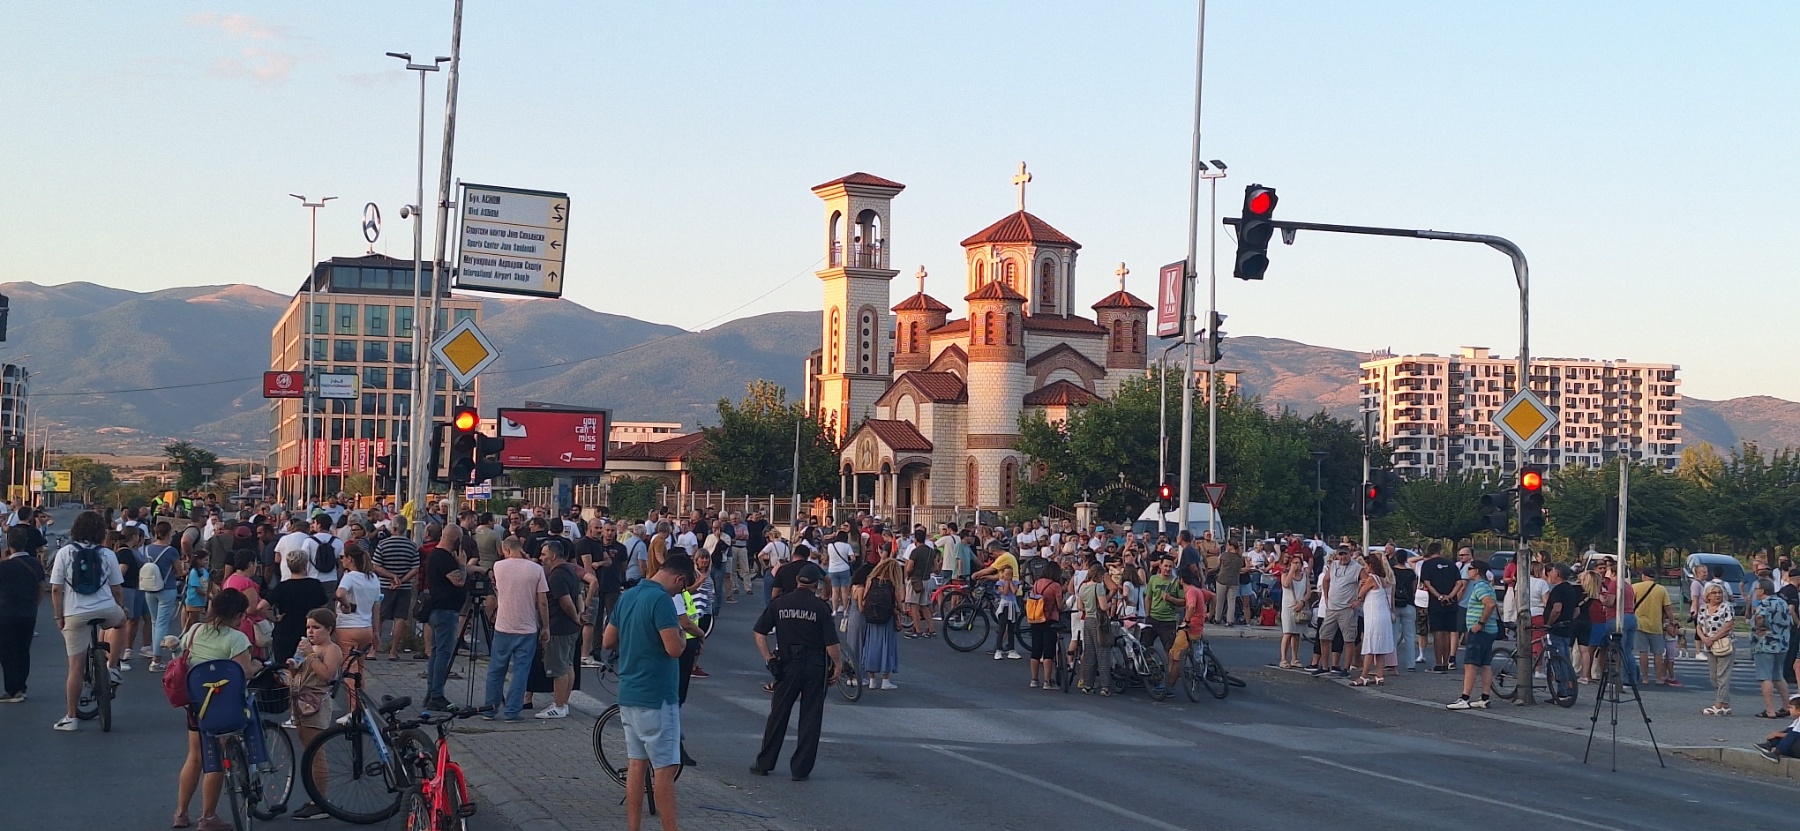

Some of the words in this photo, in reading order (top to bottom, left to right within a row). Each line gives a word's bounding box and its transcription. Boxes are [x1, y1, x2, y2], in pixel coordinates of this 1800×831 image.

[578, 434, 597, 443] miss
[584, 444, 596, 452] me
[778, 609, 817, 622] ПОЛИЦИЈА
